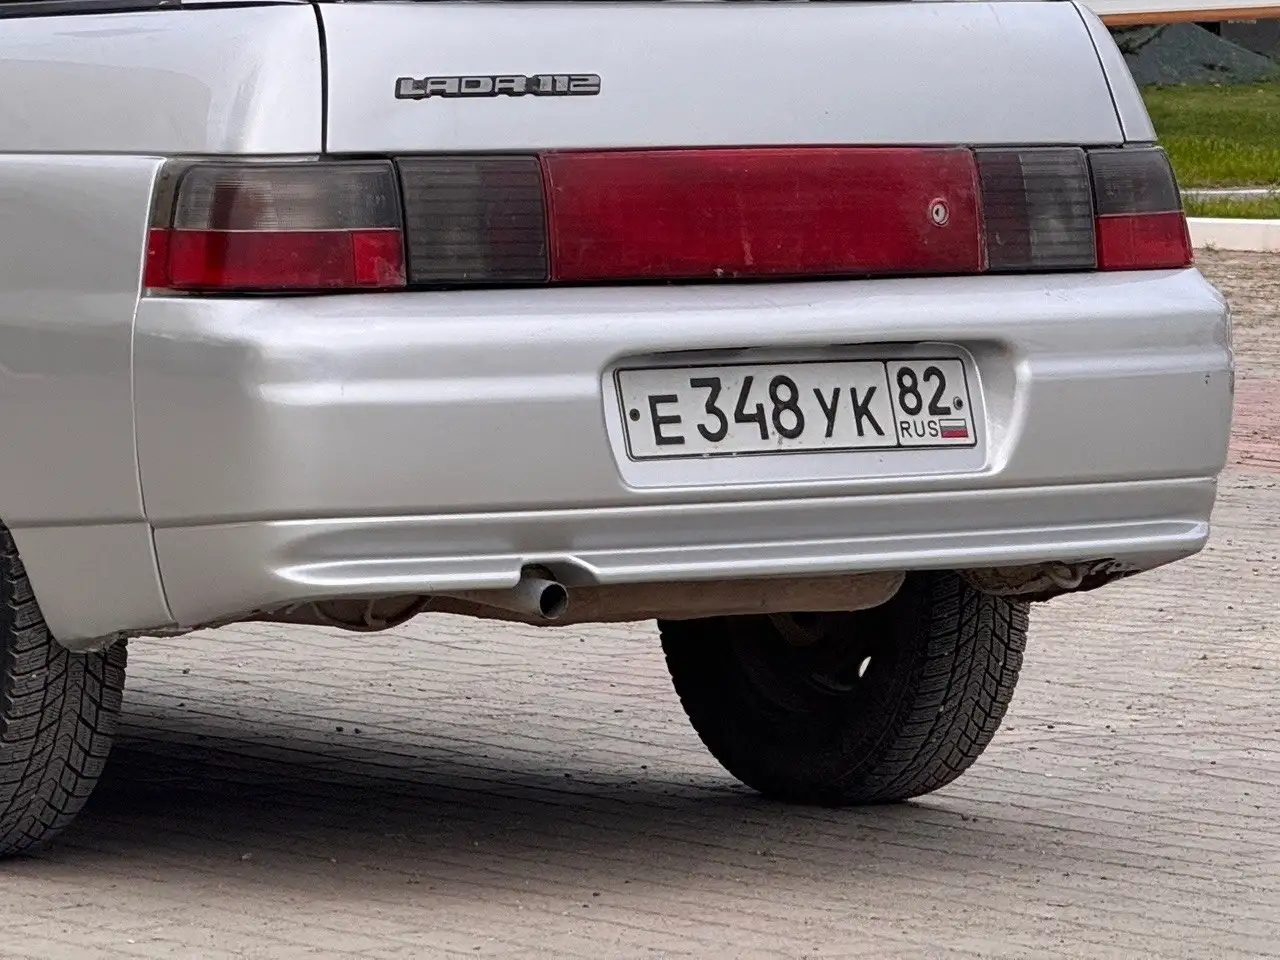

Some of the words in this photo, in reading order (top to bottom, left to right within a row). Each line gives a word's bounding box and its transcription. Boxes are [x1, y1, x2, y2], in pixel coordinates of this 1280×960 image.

[395, 75, 528, 100] LADA
[535, 73, 602, 97] 112
[896, 366, 951, 416] 82
[900, 419, 938, 439] RUS
